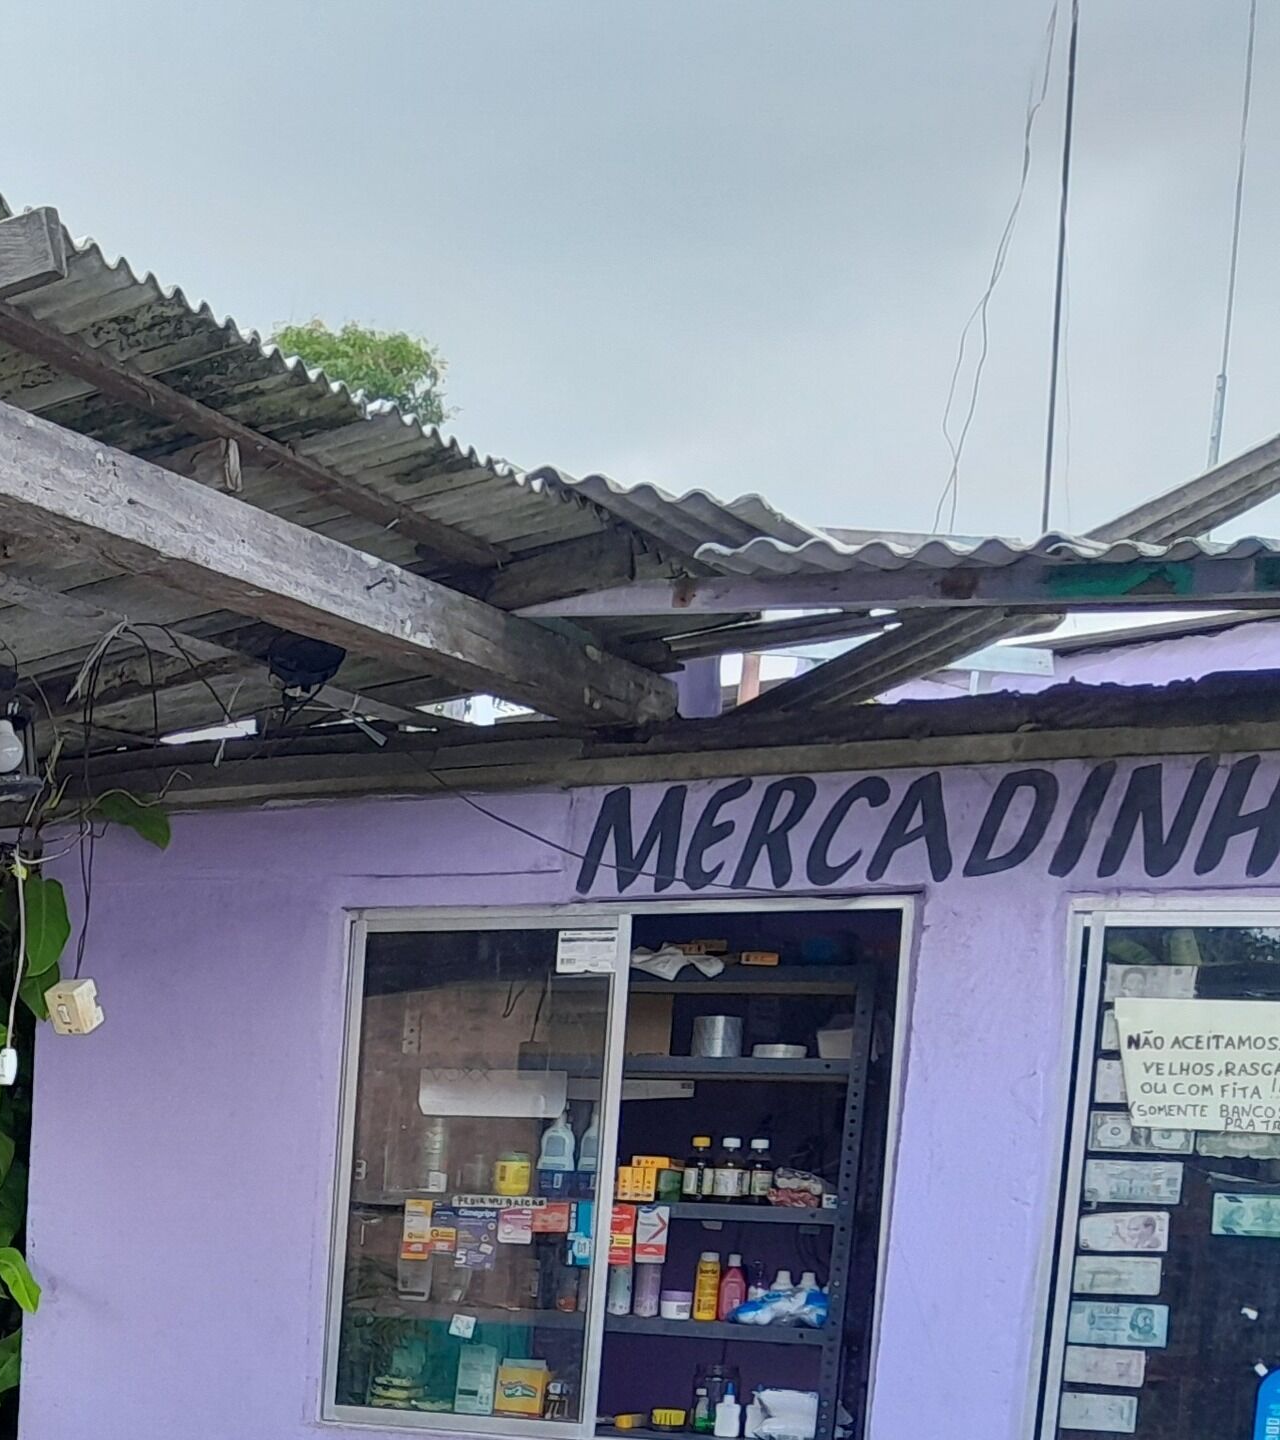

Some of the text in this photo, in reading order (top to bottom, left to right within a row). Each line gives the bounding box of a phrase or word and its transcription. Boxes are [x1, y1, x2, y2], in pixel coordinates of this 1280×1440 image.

[577, 754, 1280, 894] MERCADINH
[1127, 1030, 1165, 1051] NÃO
[1140, 1082, 1167, 1094] OU
[1173, 1082, 1213, 1096] COM
[1220, 1103, 1280, 1119] BANCO
[1224, 1116, 1256, 1132] PRA
